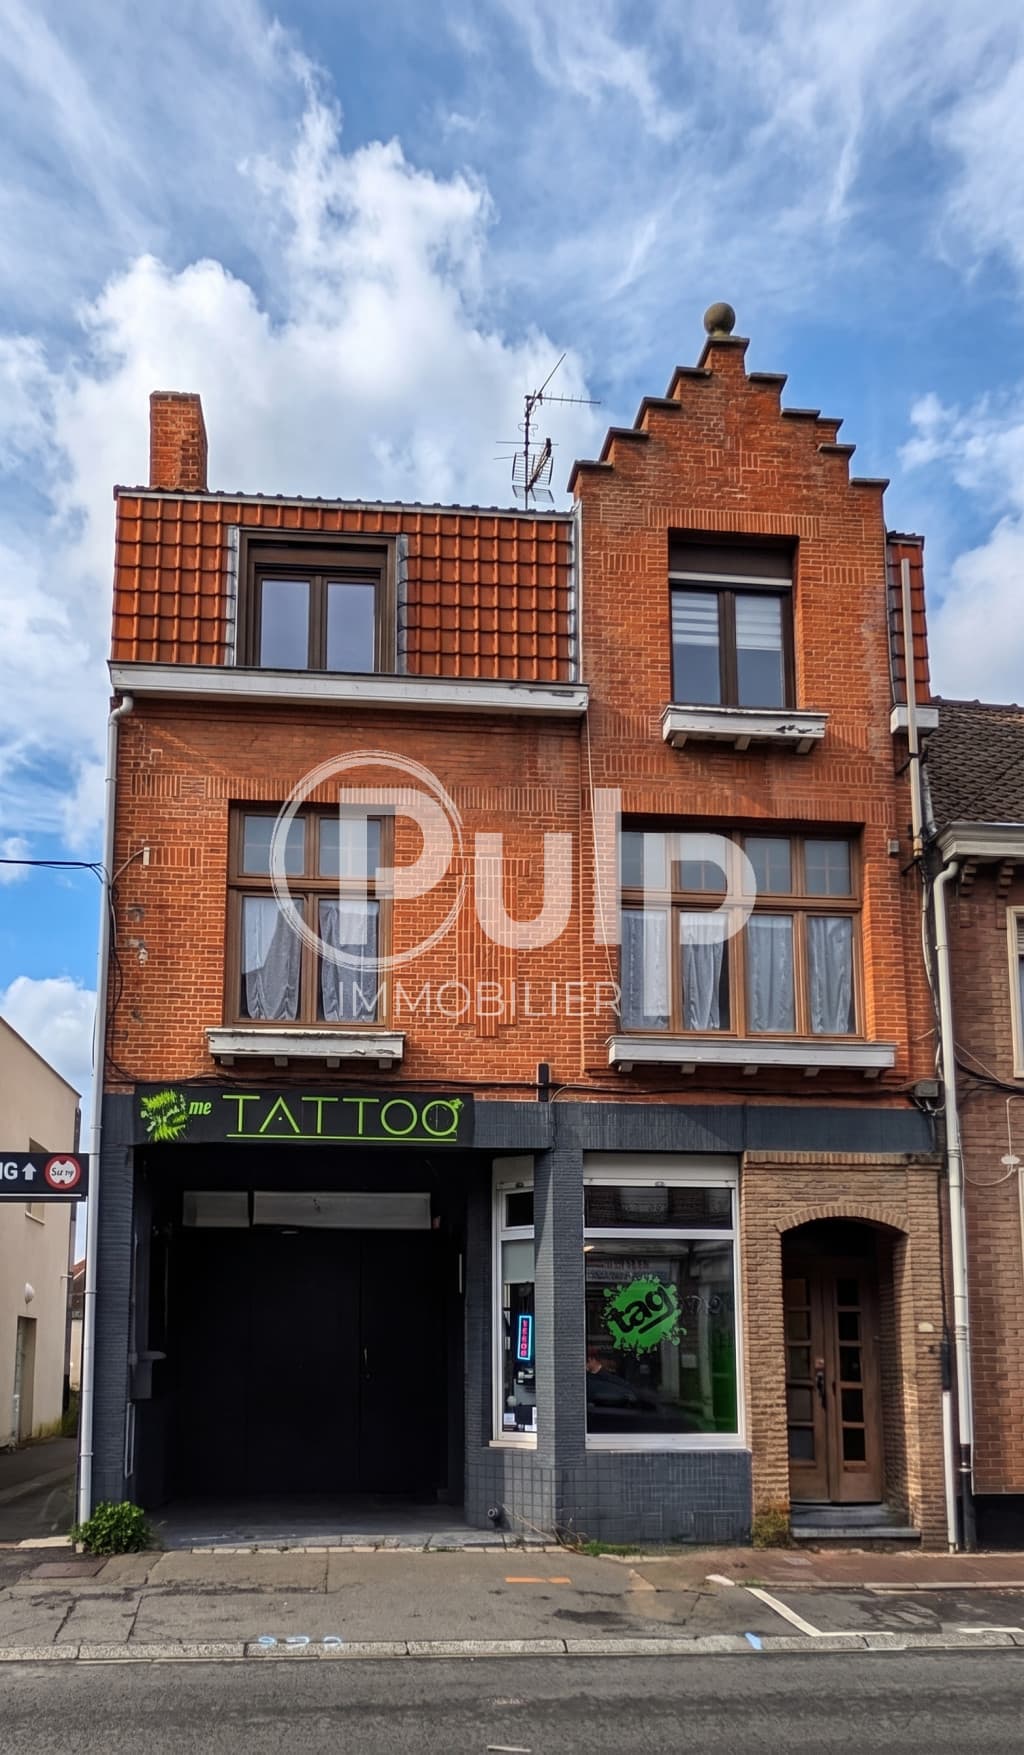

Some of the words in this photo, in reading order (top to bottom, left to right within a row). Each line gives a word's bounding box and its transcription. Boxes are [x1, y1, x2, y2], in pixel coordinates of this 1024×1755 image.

[188, 1101, 212, 1115] me
[222, 1095, 459, 1136] TATTOO
[606, 1285, 675, 1334] tag
